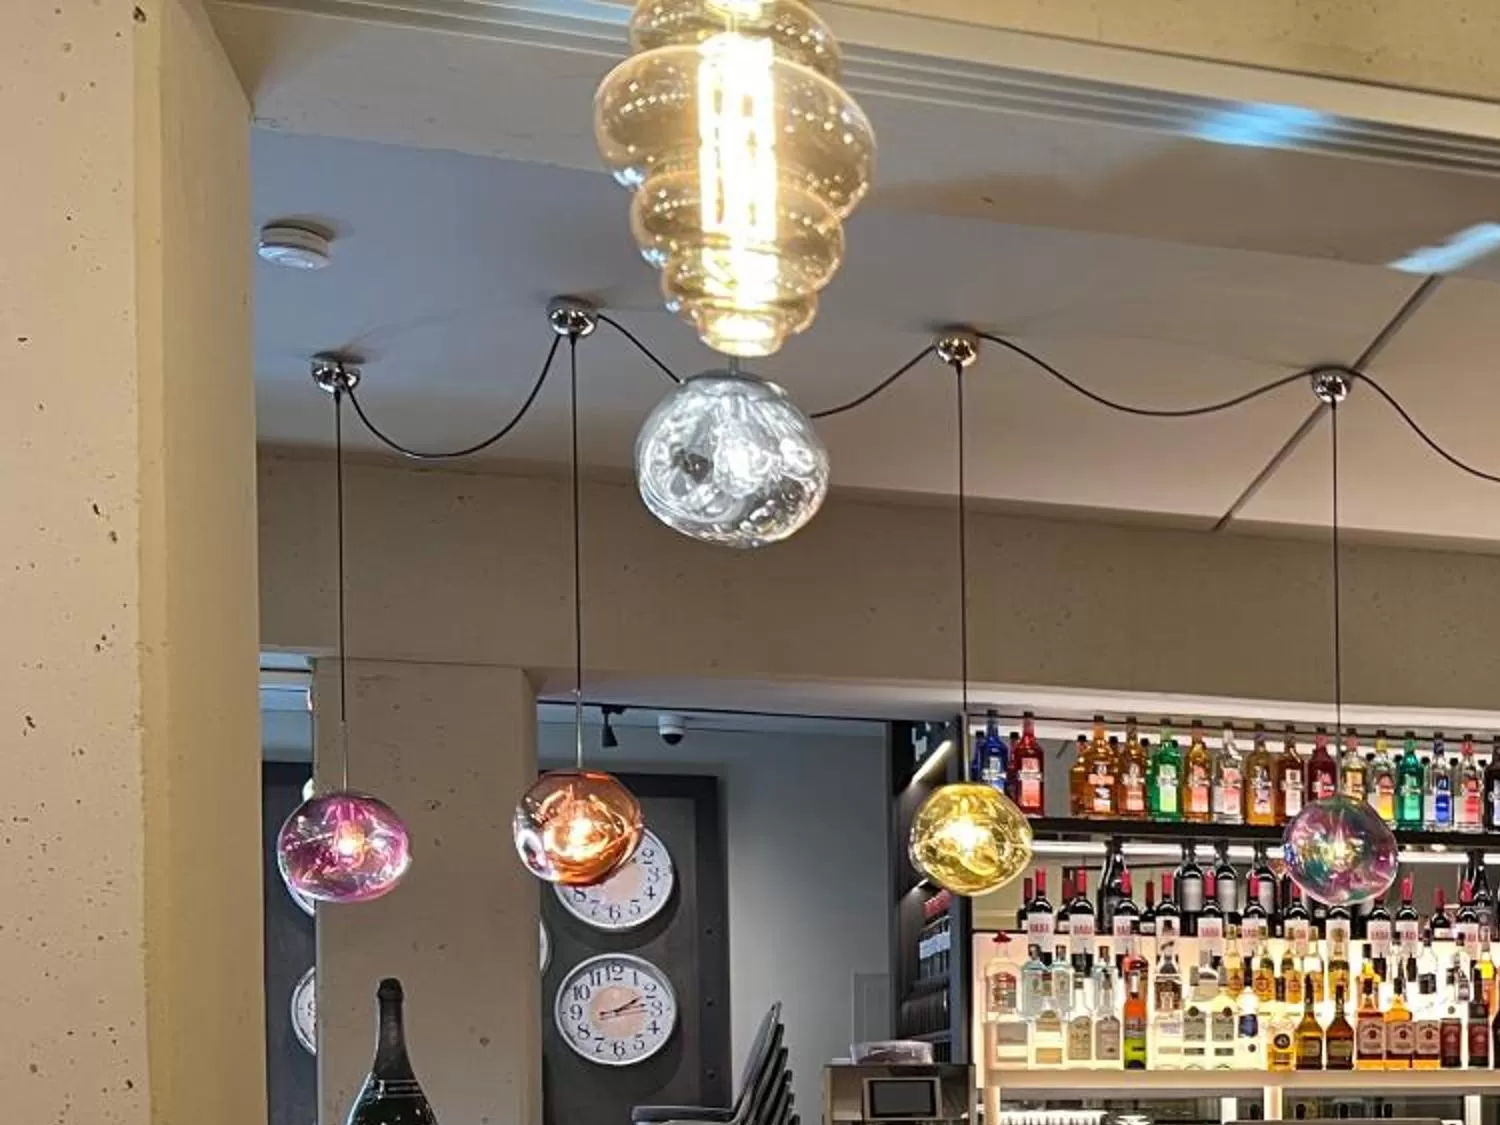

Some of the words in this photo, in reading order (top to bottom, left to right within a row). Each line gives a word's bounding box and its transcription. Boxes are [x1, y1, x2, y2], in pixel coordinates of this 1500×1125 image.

[641, 847, 655, 865] 2
[647, 867, 660, 883] 3
[574, 886, 587, 903] 8
[643, 885, 657, 900] 4
[591, 899, 601, 916] 7
[609, 904, 621, 922] 6
[629, 899, 641, 915] 5
[589, 969, 602, 986] 11
[605, 962, 624, 981] 12
[573, 983, 591, 1001] 10
[643, 983, 657, 999] 2
[569, 1004, 583, 1021] 9
[650, 1000, 663, 1017] 3
[577, 1023, 591, 1041] 8
[647, 1020, 661, 1035] 4
[594, 1037, 605, 1053] 7
[613, 1041, 625, 1057] 6
[632, 1033, 645, 1051] 5
